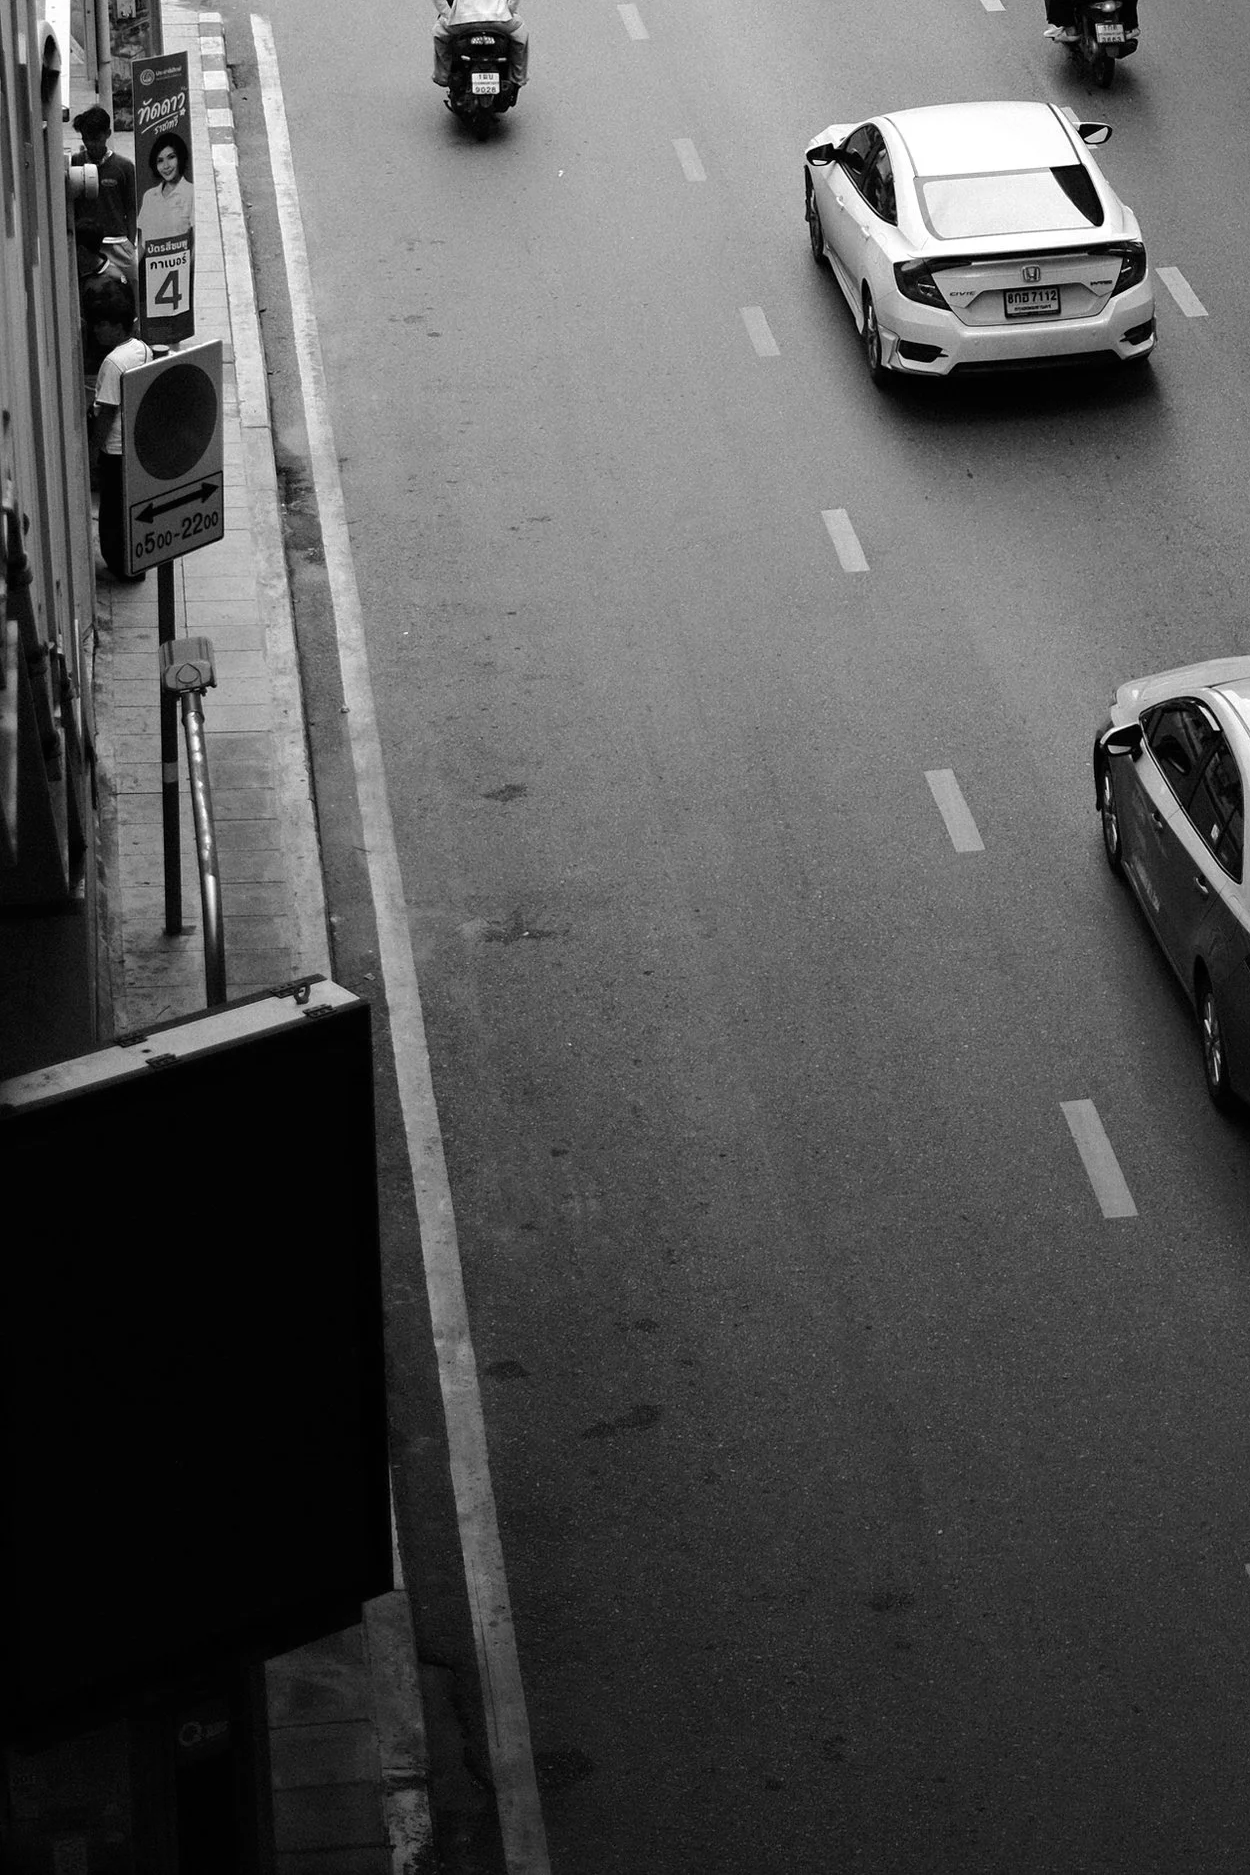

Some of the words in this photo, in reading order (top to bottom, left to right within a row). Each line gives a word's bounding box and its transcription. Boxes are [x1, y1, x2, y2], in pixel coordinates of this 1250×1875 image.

[475, 86, 497, 94] 9028
[150, 252, 187, 270] กาเบอร์
[154, 269, 183, 311] 4
[1032, 290, 1057, 302] 7112
